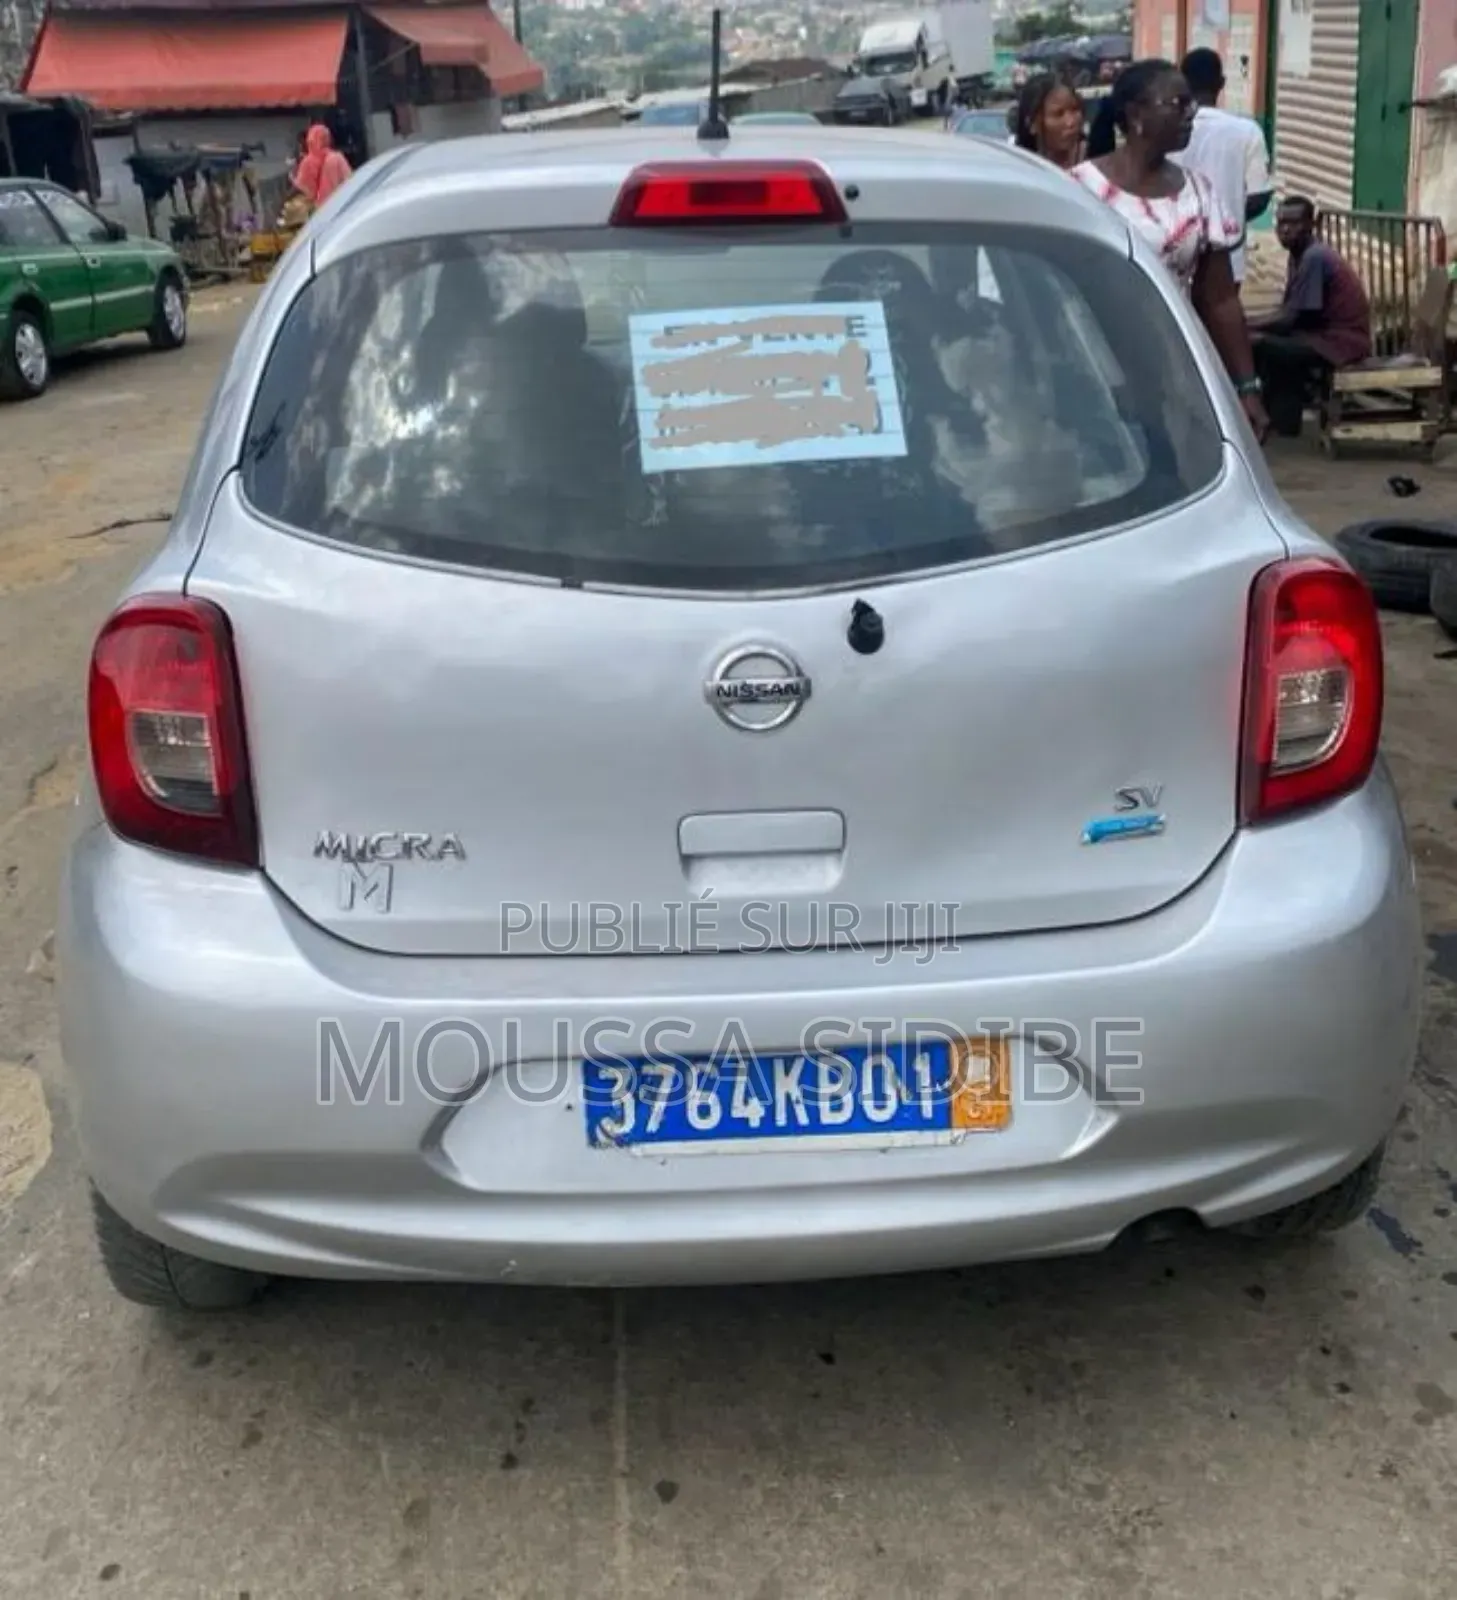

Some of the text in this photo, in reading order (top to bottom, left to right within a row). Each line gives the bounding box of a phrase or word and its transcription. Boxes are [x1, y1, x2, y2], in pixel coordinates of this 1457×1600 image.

[717, 681, 801, 698] NISSAN
[1114, 783, 1163, 812] SV
[313, 830, 468, 863] MICRA
[596, 1052, 935, 1136] 3764KB01
